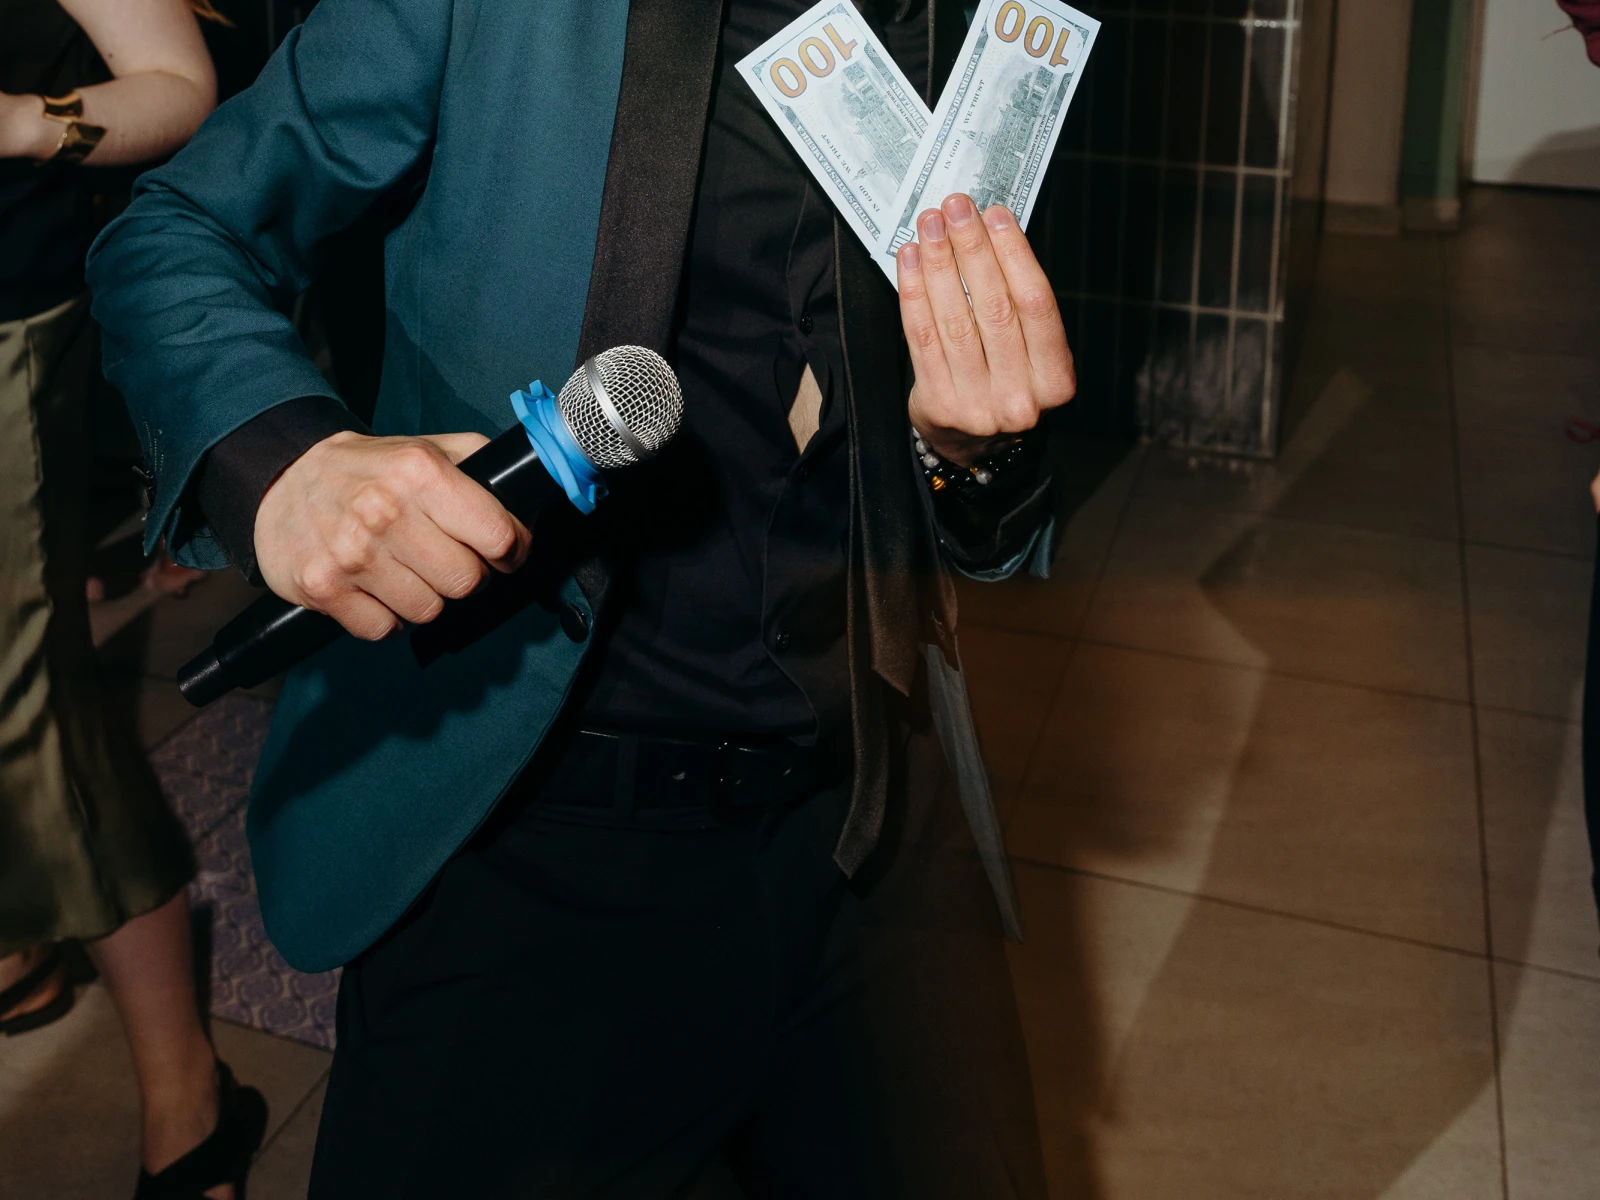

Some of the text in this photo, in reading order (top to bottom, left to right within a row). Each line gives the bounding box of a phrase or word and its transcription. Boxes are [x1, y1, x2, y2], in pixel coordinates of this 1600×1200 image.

[769, 22, 858, 97] 100
[994, 0, 1070, 67] 100
[943, 79, 985, 169] IN GOD WE TRUST
[820, 132, 880, 212] IN GOD WE TRUST
